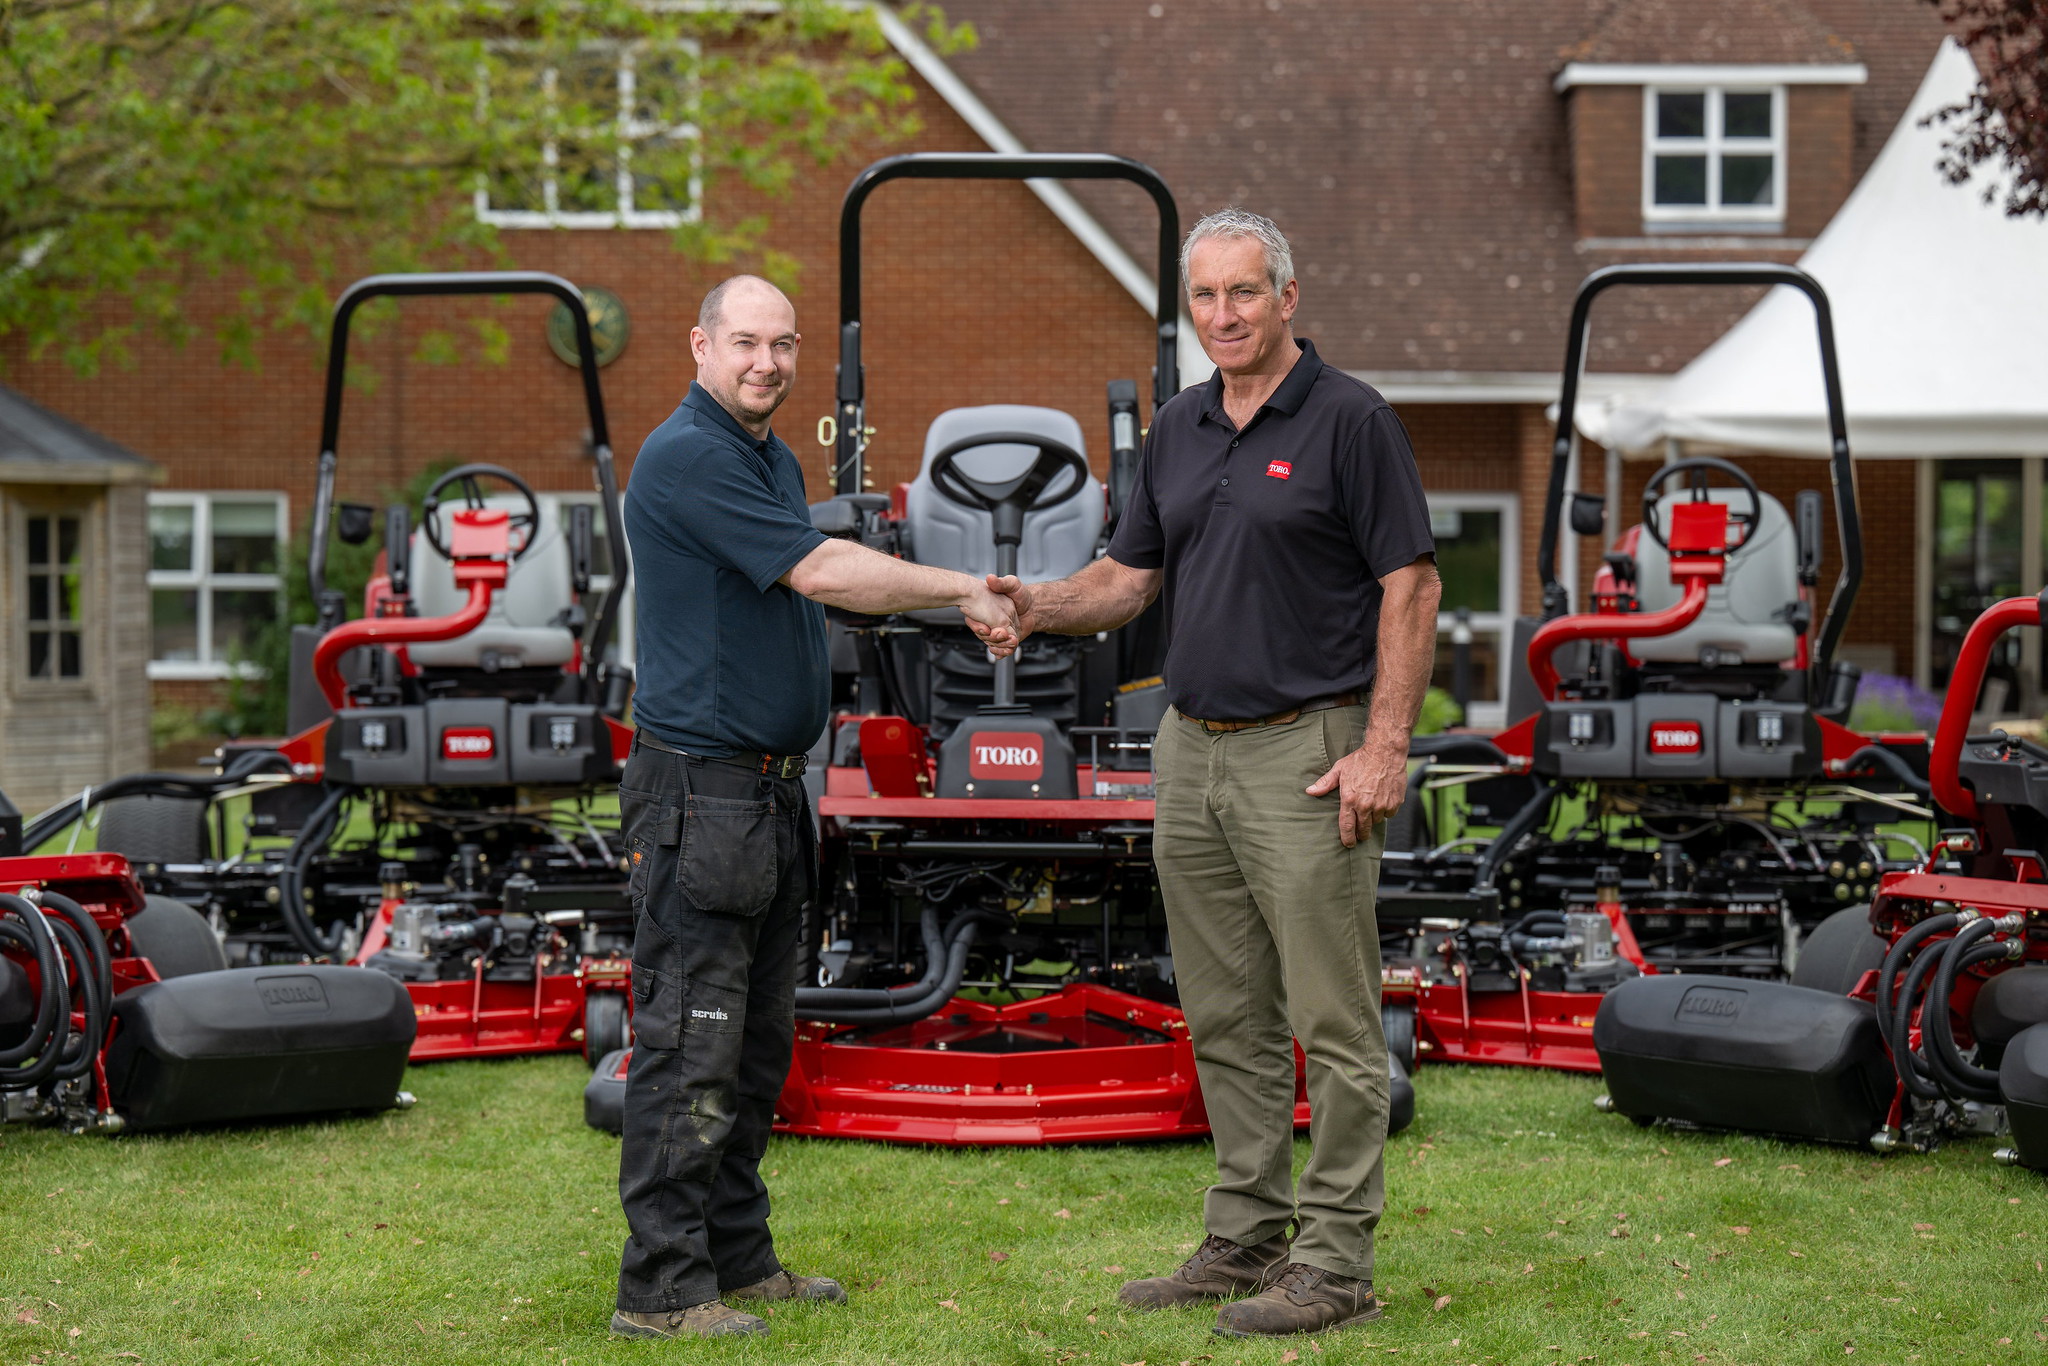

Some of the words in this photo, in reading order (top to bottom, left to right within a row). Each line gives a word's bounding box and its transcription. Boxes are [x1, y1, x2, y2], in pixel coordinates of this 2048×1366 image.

[446, 736, 491, 753] TORO
[1653, 730, 1698, 746] TORO
[264, 986, 321, 1005] TORO
[1683, 996, 1738, 1017] TORO
